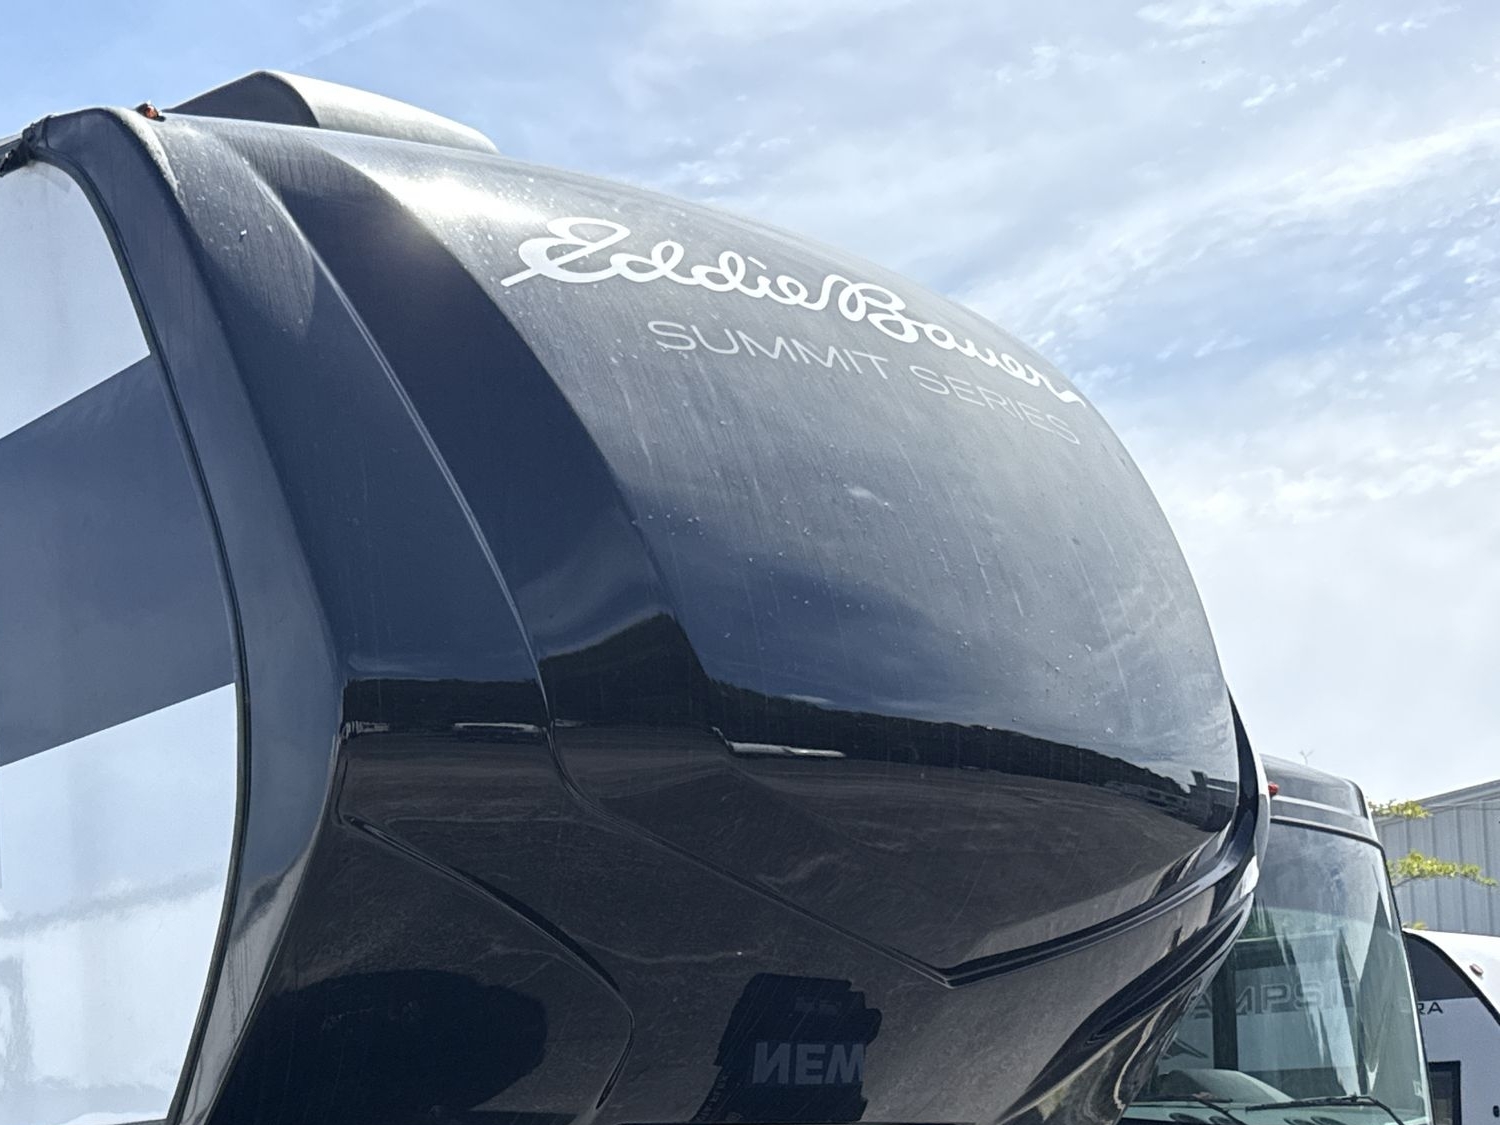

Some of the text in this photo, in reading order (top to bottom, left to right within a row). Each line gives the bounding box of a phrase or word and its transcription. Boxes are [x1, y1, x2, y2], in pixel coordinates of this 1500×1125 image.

[500, 217, 1087, 407] Eddie Bauer
[647, 320, 1082, 446] SUMMIT SERIES
